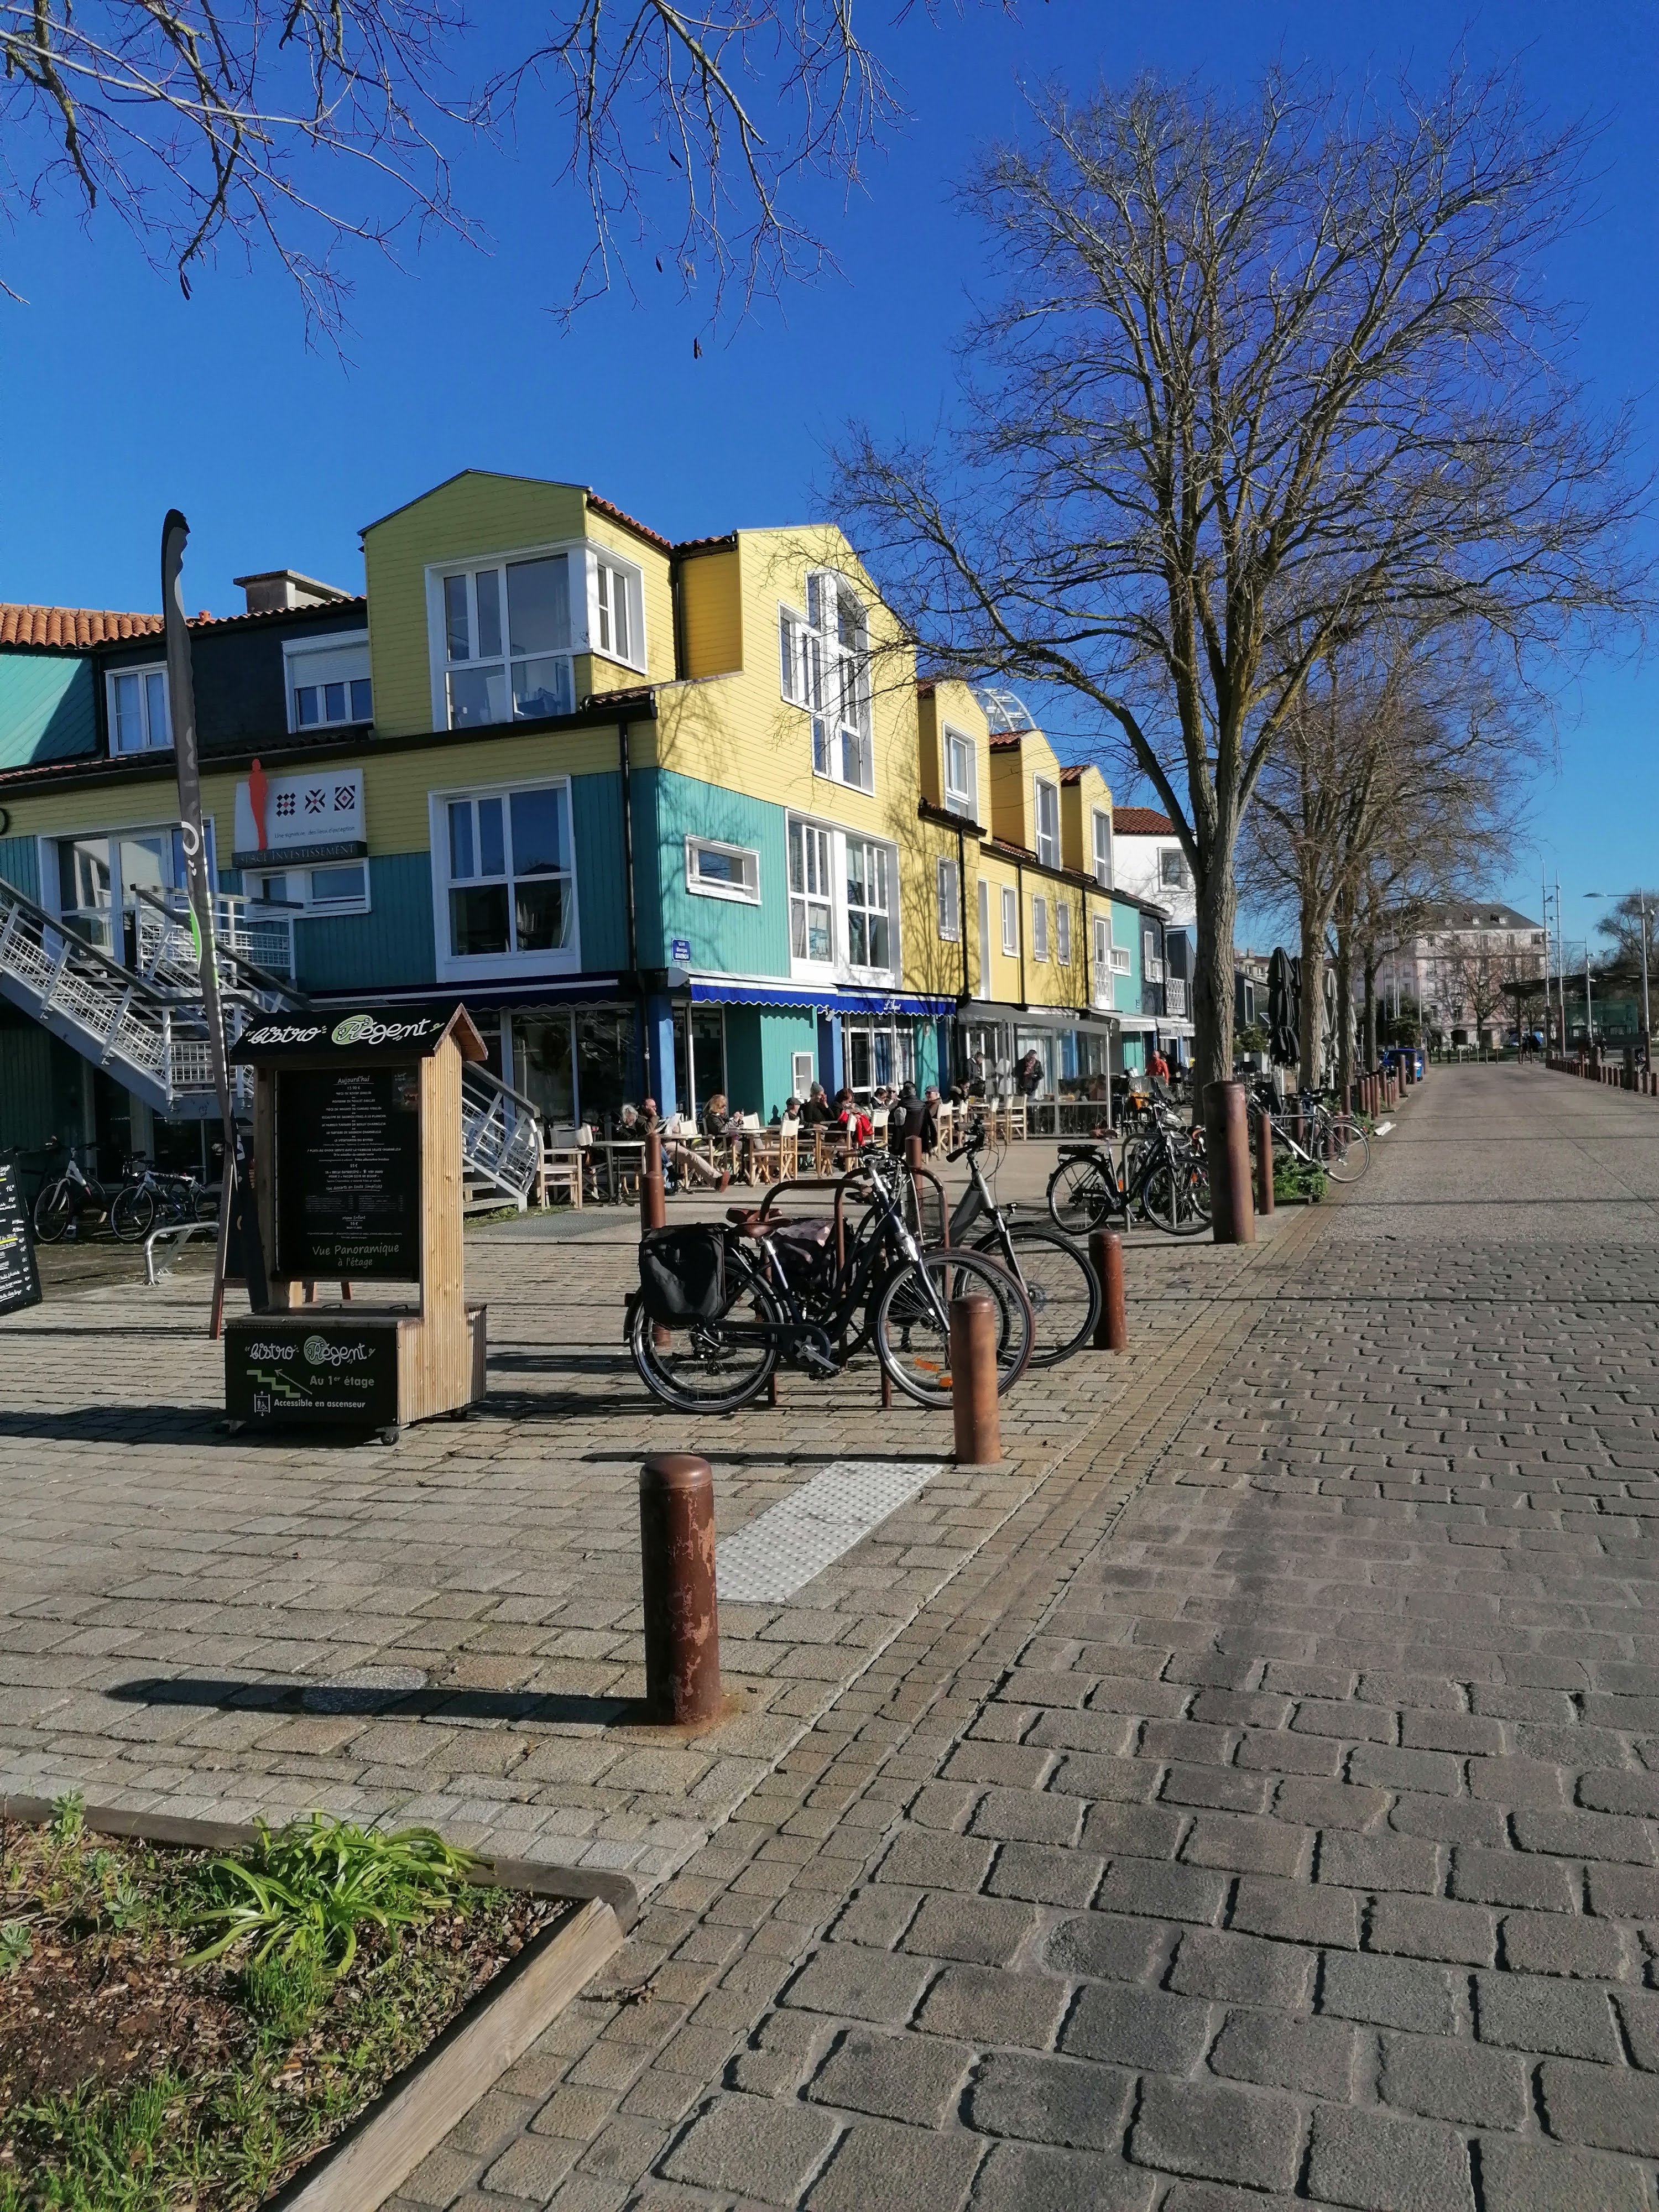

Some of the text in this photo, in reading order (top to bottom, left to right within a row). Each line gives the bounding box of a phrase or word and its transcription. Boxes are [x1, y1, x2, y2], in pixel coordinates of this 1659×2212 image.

[248, 1018, 431, 1045] bistro Régent
[337, 1075, 370, 1085] Aujourd'hui
[312, 1242, 399, 1256] Vue Panoramique
[337, 1256, 373, 1269] à l'étage
[250, 1339, 367, 1366] bistro Régent
[310, 1375, 375, 1388] Au 1er étage
[274, 1399, 313, 1407] Accessible
